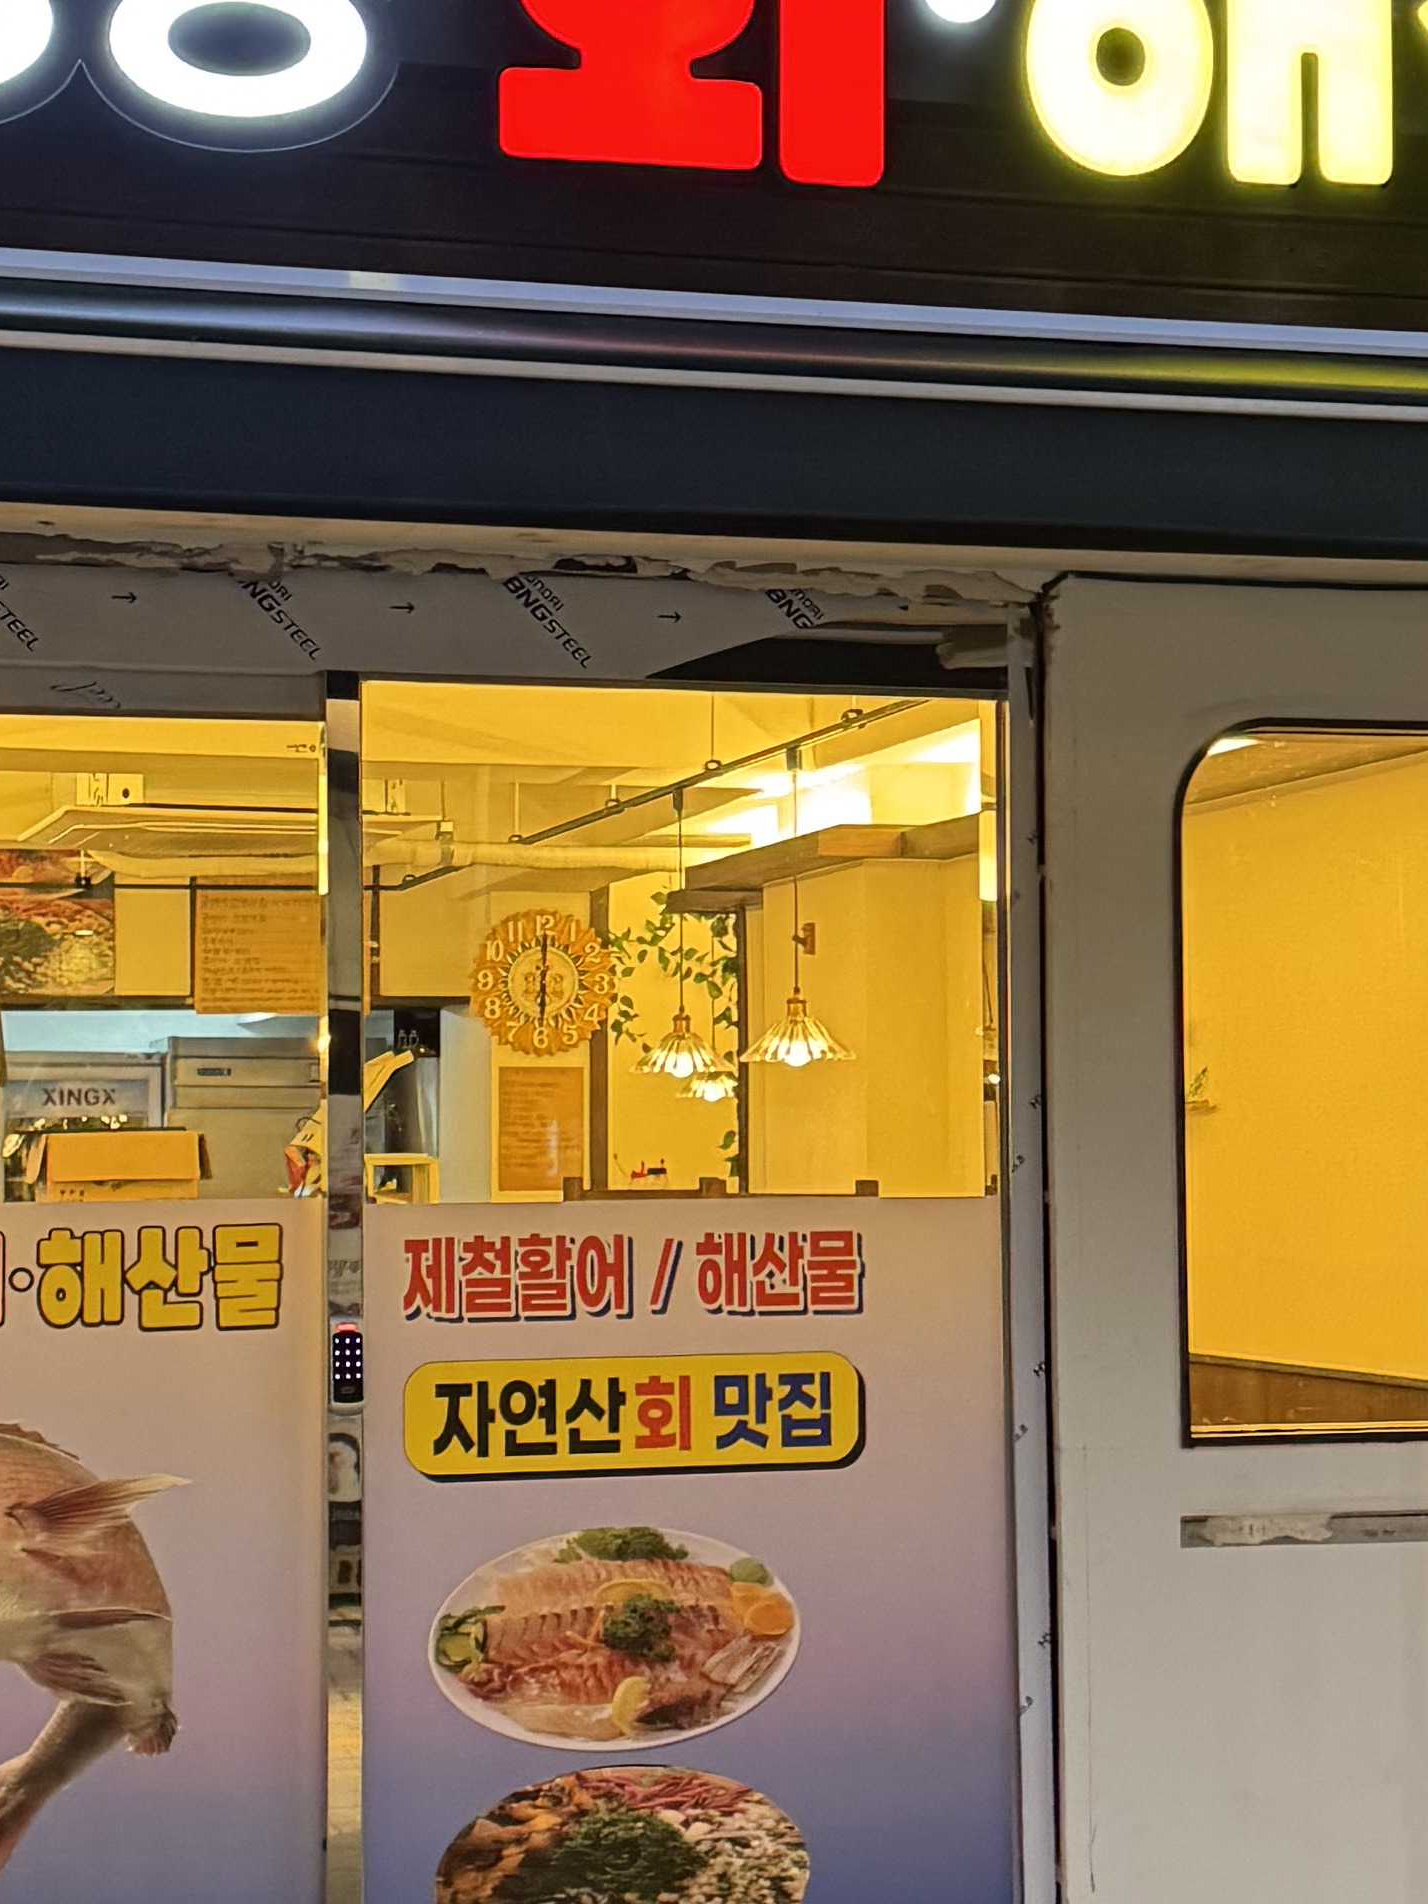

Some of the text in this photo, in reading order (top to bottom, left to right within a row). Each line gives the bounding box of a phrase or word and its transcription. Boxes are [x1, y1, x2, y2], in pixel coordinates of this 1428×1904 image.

[402, 1231, 634, 1322] 제철활어
[696, 1229, 866, 1317] 해산물
[433, 1371, 833, 1459] 자연산회 맛집
